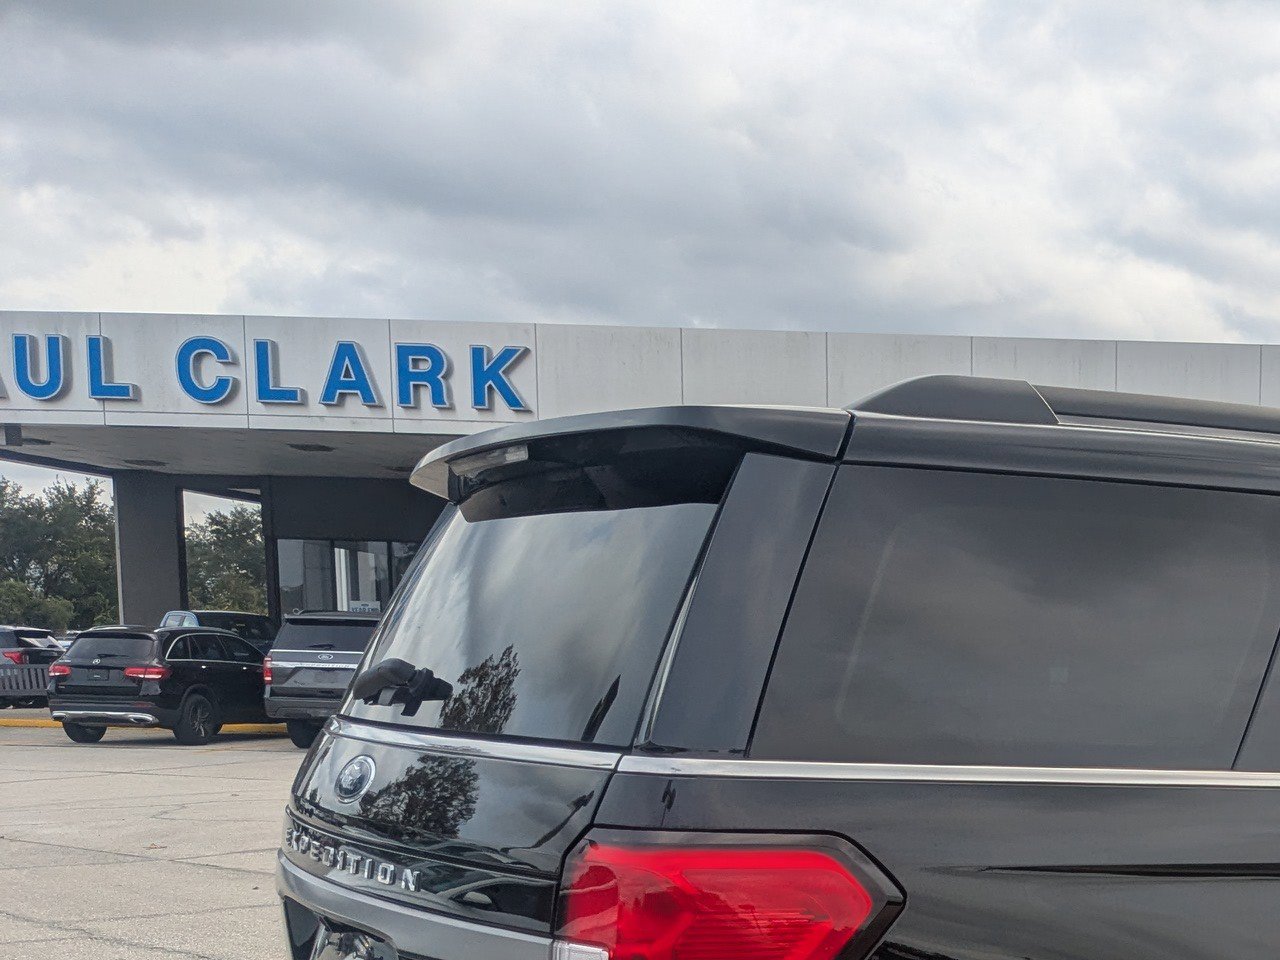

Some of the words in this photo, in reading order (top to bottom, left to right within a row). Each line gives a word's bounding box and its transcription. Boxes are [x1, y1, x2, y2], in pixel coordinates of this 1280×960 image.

[0, 333, 135, 401] UL
[175, 335, 530, 411] CLARK
[286, 827, 422, 892] EXPEDITION
